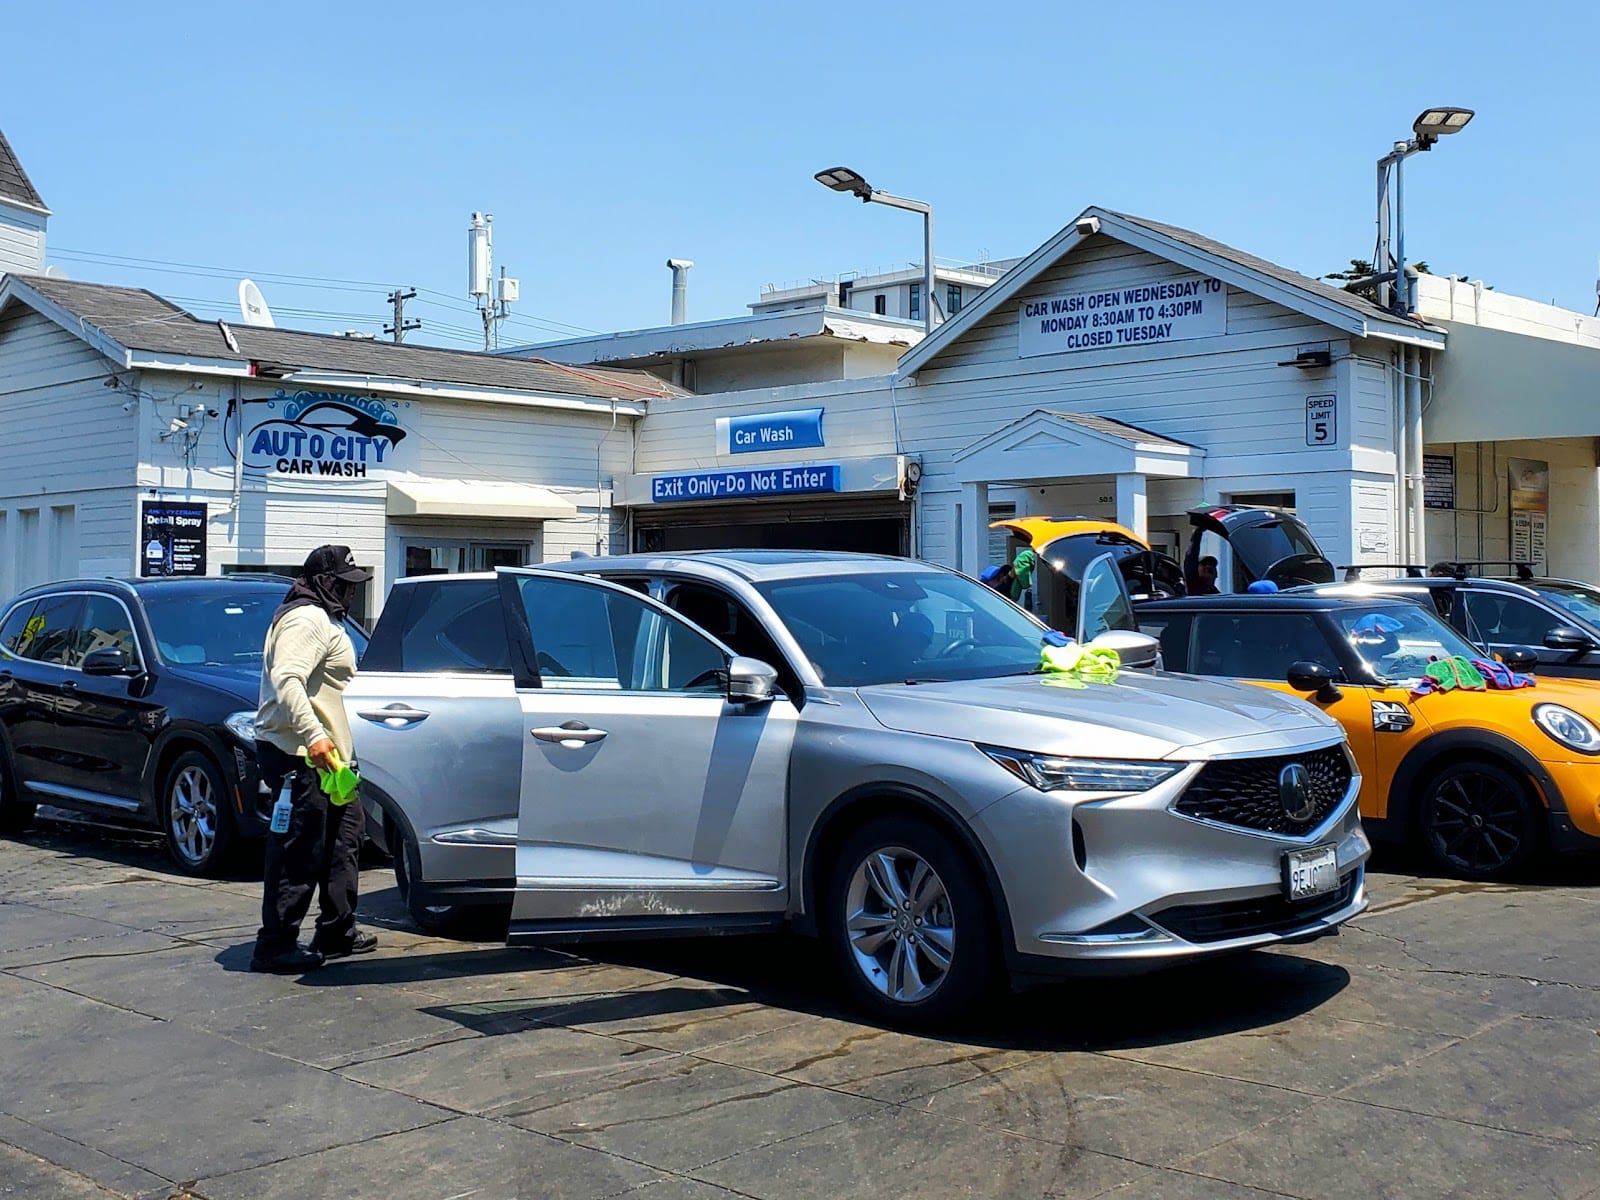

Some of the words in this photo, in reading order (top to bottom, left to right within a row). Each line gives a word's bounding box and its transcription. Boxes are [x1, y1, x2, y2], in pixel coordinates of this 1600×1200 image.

[1025, 301, 1048, 318] CAR
[1051, 296, 1084, 314] WASH
[1088, 292, 1120, 309] OPEN
[1123, 281, 1200, 304] WEDNESDAY
[1203, 278, 1221, 294] TO
[1041, 315, 1089, 334] MONDAY
[1093, 309, 1134, 328] 8:30AM
[1138, 306, 1154, 321] TO
[1158, 299, 1202, 319] 4:30PM
[1067, 330, 1113, 349] CLOSED
[1116, 323, 1173, 343] TUESDAY
[1308, 400, 1334, 409] SPEED
[1310, 411, 1331, 420] LIMIT
[735, 430, 756, 445] Car
[760, 425, 793, 443] Wash
[1315, 422, 1328, 441] 5
[251, 429, 325, 459] AUTO
[330, 436, 389, 463] CITY
[276, 458, 313, 475] CAR
[317, 460, 366, 478] WASH
[655, 477, 683, 497] Exit
[751, 471, 777, 491] Not
[783, 469, 826, 489] Enter
[147, 515, 175, 525] Detail
[175, 516, 202, 528] Spray
